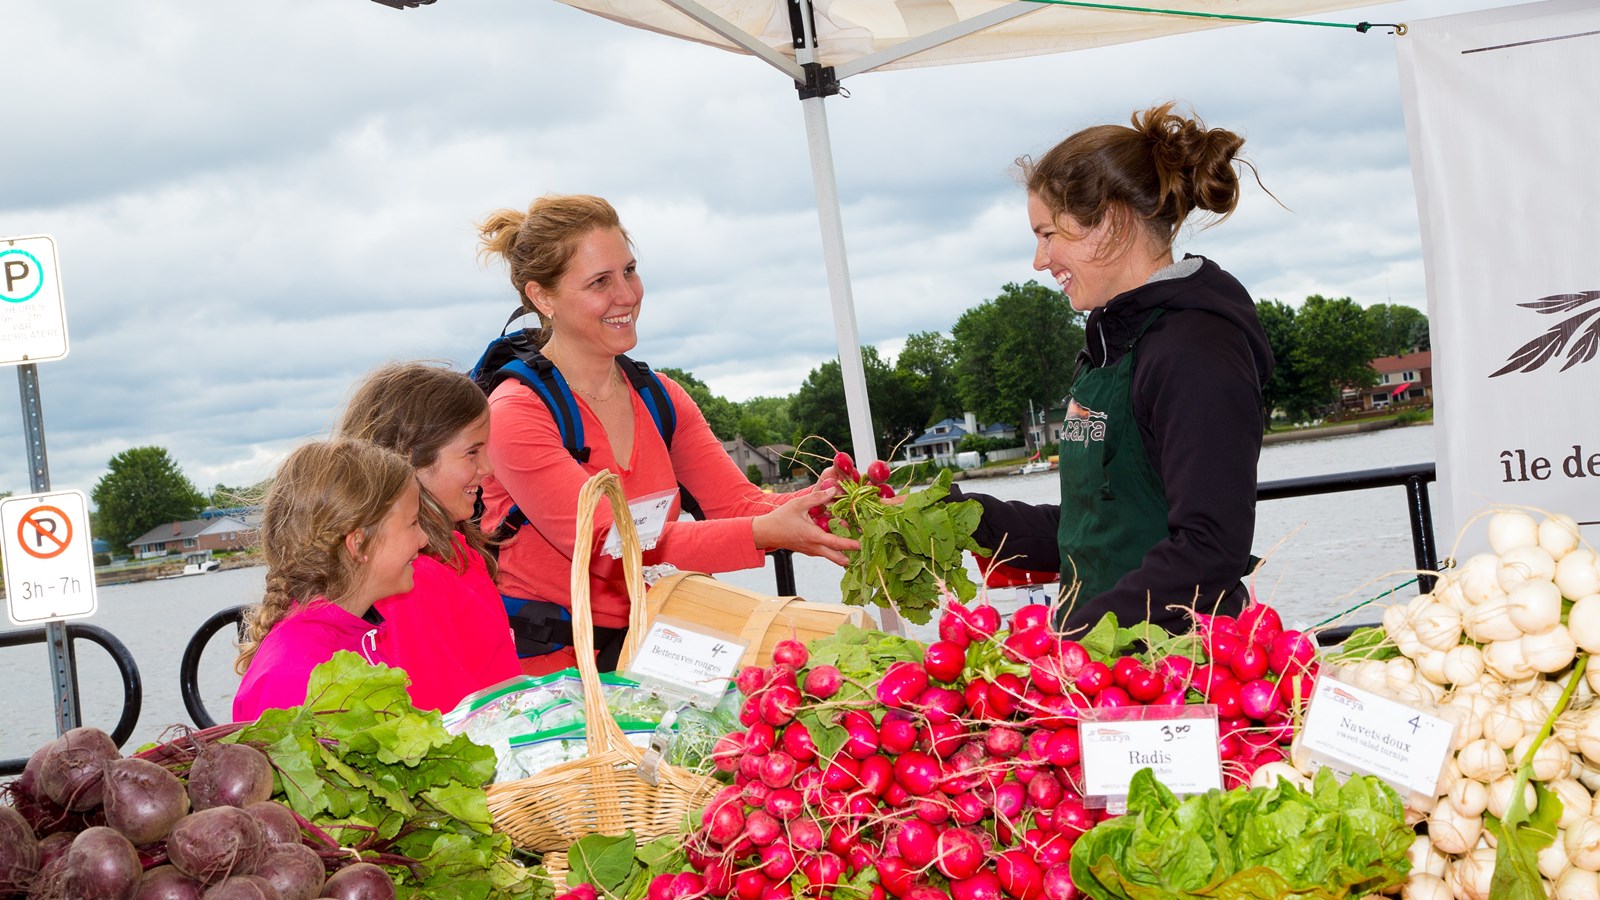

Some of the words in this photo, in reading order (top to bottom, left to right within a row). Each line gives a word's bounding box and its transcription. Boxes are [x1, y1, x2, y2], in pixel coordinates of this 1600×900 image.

[4, 261, 29, 292] P
[1500, 448, 1551, 482] île
[651, 644, 693, 665] Betteraves
[694, 658, 722, 673] rouges
[1340, 716, 1381, 740] Navets
[1382, 733, 1412, 753] doux
[1359, 738, 1380, 752] salad
[1128, 749, 1172, 765] Radis
